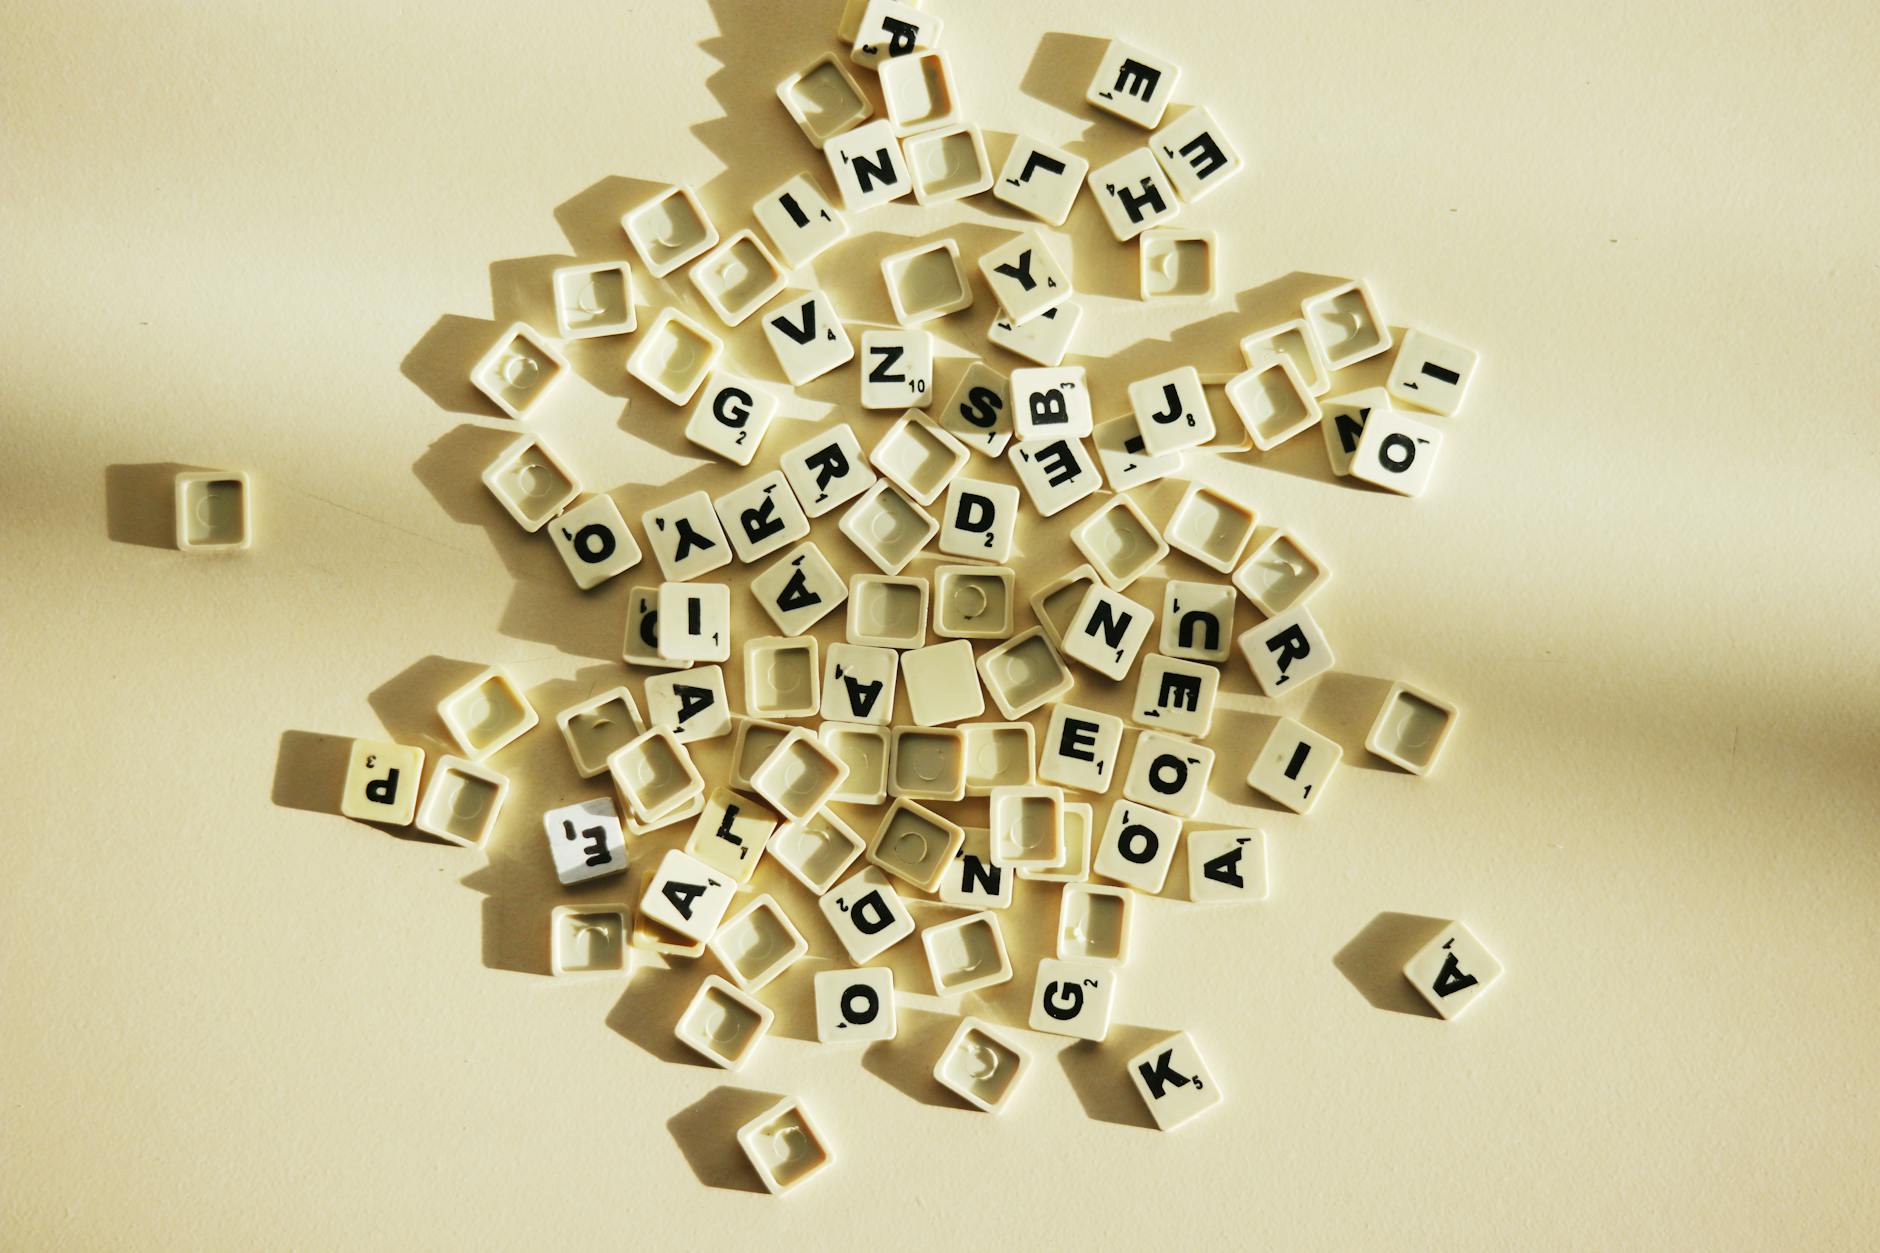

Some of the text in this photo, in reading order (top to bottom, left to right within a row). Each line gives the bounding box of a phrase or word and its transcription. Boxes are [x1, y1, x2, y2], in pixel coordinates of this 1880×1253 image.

[862, 17, 918, 57] P 3
[1099, 59, 1161, 101] E 1
[840, 149, 897, 192] N 1
[1006, 151, 1065, 187] L 1
[1163, 132, 1227, 179] E 1
[779, 193, 831, 227] I 1
[1106, 177, 1166, 222] H 4
[995, 250, 1057, 290] Y 4
[771, 301, 836, 344] V 4
[870, 347, 925, 393] Z 10
[1403, 362, 1459, 390] I 1
[713, 388, 752, 445] G 2
[960, 387, 1003, 444] S 1
[1030, 381, 1075, 425] B 3
[1151, 384, 1196, 427] J 8
[805, 443, 849, 504] R 1
[1019, 440, 1081, 487] E 1
[1379, 433, 1415, 473] O
[741, 484, 785, 544] R 1
[955, 493, 995, 548] D 2
[561, 524, 615, 563] O 1
[655, 517, 715, 562] Y 4
[777, 555, 821, 612] A 1
[688, 597, 719, 647] I 1
[1085, 600, 1132, 663] N 1
[1173, 598, 1219, 650] U 1
[1266, 624, 1310, 686] R 1
[673, 684, 714, 723] A
[835, 663, 883, 717] A 1
[1143, 672, 1201, 718] E 1
[1059, 718, 1104, 775] E 1
[365, 755, 399, 804] P 3
[1149, 754, 1201, 794] O 1
[1285, 742, 1312, 799] I 1
[582, 826, 612, 866] E
[717, 804, 749, 860] L 1
[1118, 810, 1158, 863] O 1
[962, 855, 1001, 895] N
[1204, 836, 1252, 888] A 1
[662, 878, 722, 920] A 1
[836, 890, 895, 934] D 2
[1433, 937, 1478, 997] A 1
[841, 985, 878, 1024] O
[1044, 978, 1098, 1020] G 2
[1139, 1049, 1203, 1099] K 5
